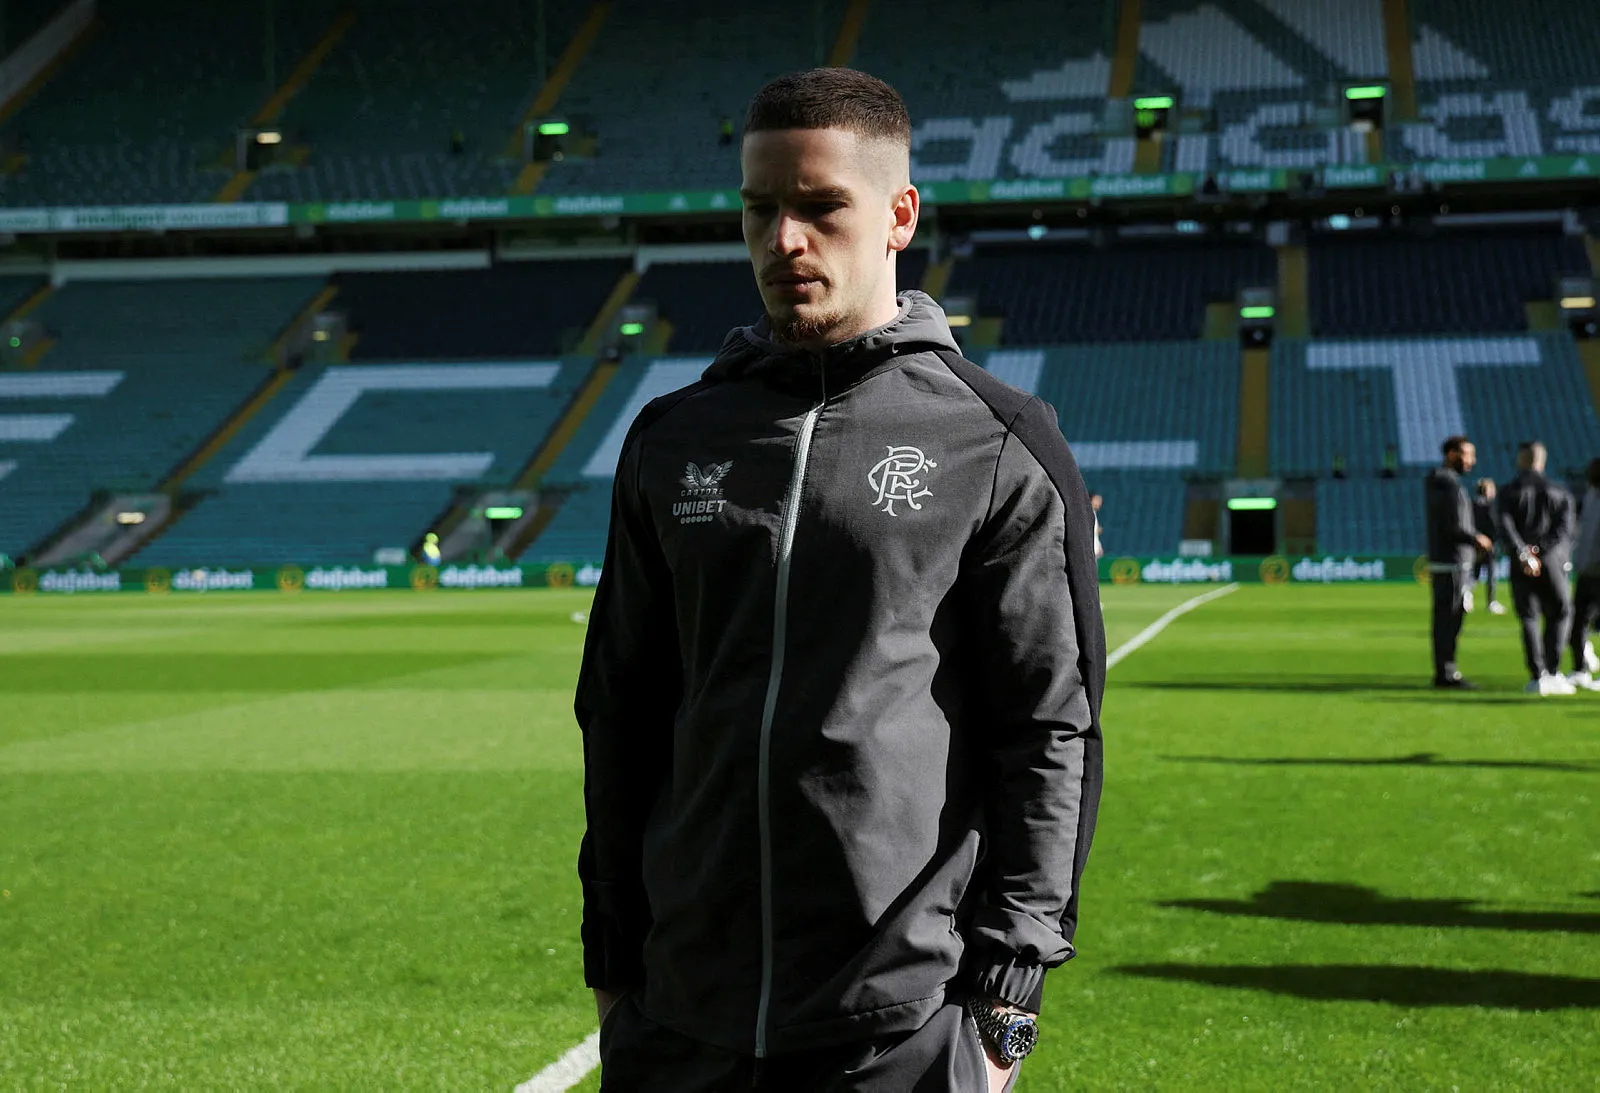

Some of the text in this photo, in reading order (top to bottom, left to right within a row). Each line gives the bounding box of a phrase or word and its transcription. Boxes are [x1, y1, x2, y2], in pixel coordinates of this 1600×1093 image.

[672, 499, 728, 516] UNIBET
[40, 568, 121, 593] dafabet
[305, 566, 387, 590] dafabet
[439, 565, 522, 589] dafabet
[1142, 558, 1232, 584] dafabet
[1292, 557, 1384, 583] dafabet
